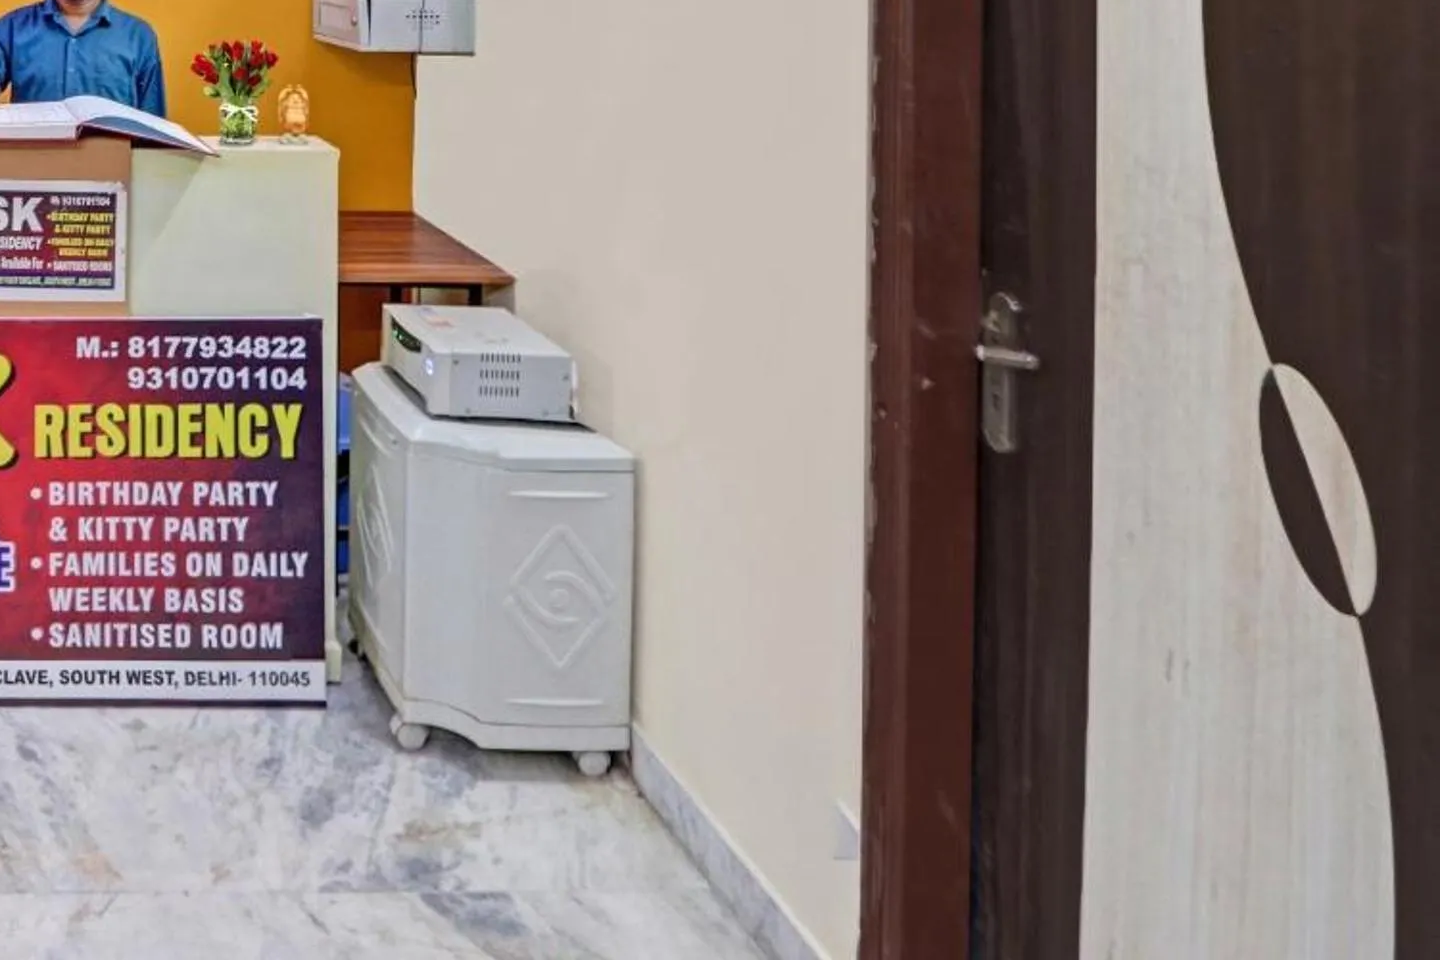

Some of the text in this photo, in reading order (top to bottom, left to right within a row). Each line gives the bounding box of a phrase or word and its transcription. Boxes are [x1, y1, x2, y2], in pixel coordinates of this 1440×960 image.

[128, 336, 307, 359] 8177934822
[128, 367, 307, 390] 9310701104
[34, 403, 303, 459] RESIDENCY
[49, 481, 278, 507] BIRTHDAY PARTY
[49, 517, 249, 542] & KITTY PARTY
[49, 552, 309, 577] FAMILIES ON DAILY
[49, 588, 244, 613] WEEKLY BASIS
[49, 623, 283, 649] SANITISED ROOM
[59, 670, 120, 686] SOUTH
[126, 670, 179, 688] WEST,
[185, 671, 242, 686] DELHI-
[250, 671, 310, 687] 110045
